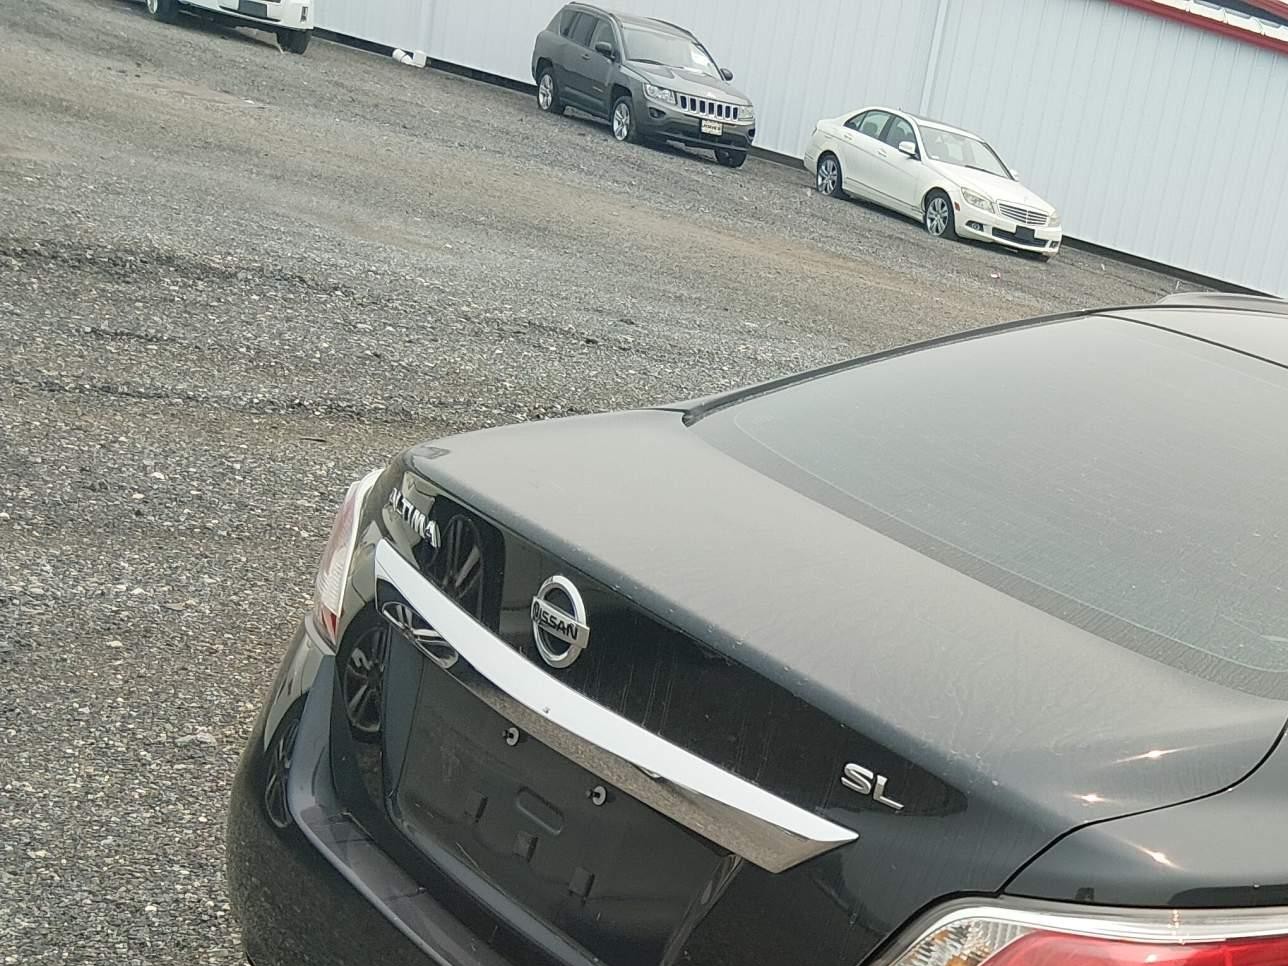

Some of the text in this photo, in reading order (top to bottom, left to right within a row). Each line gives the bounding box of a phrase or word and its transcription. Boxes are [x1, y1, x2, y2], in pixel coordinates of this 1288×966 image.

[389, 487, 441, 548] ALTIMA
[531, 599, 579, 641] NISSAN
[840, 762, 905, 810] SL
